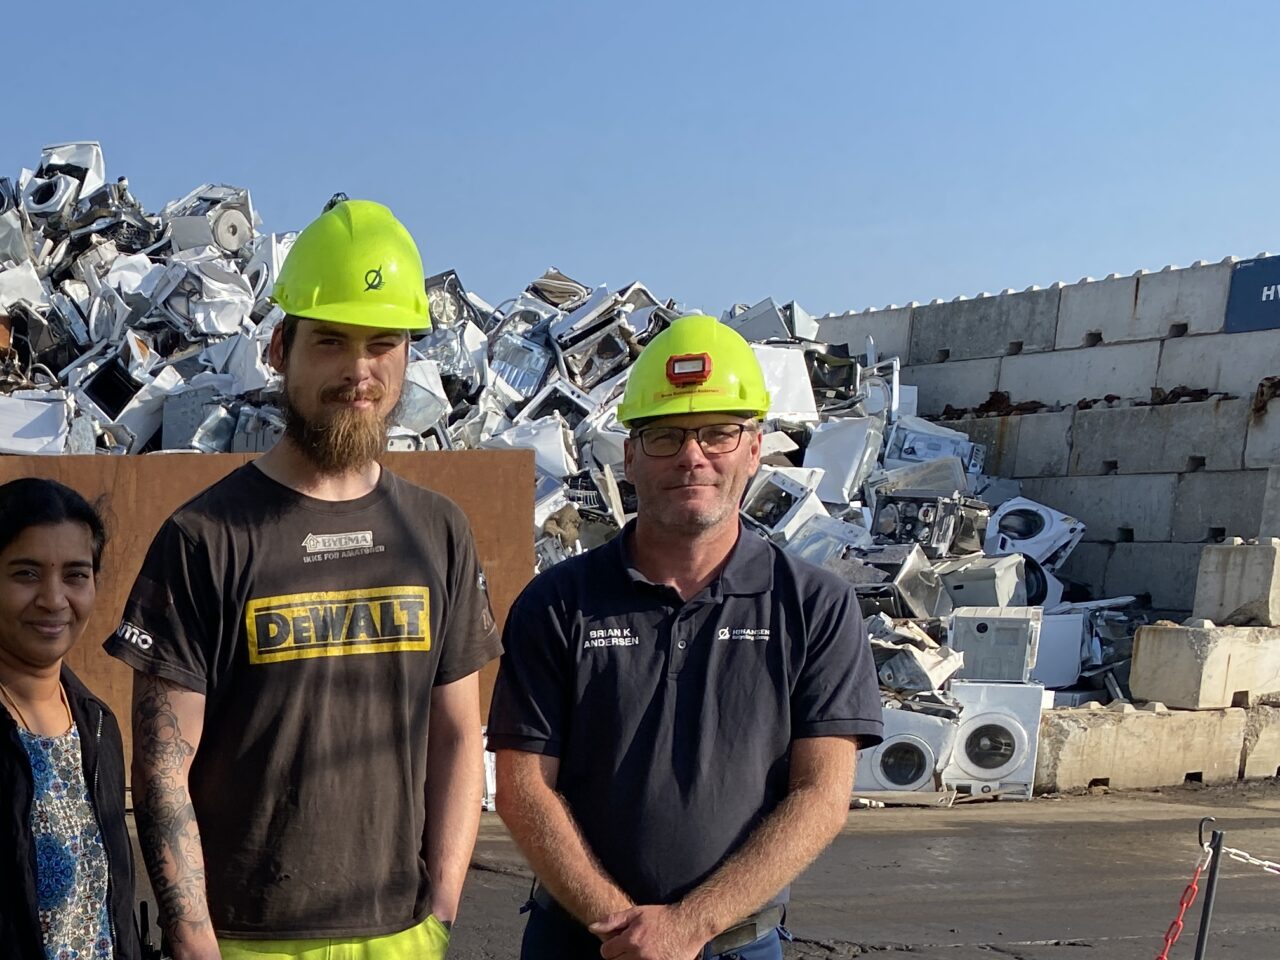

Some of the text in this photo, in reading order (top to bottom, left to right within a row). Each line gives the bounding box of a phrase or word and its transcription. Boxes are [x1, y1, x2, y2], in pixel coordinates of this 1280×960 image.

[255, 600, 424, 649] DEWALT
[589, 628, 631, 639] BRIAN K
[584, 636, 639, 649] ANDERSEN
